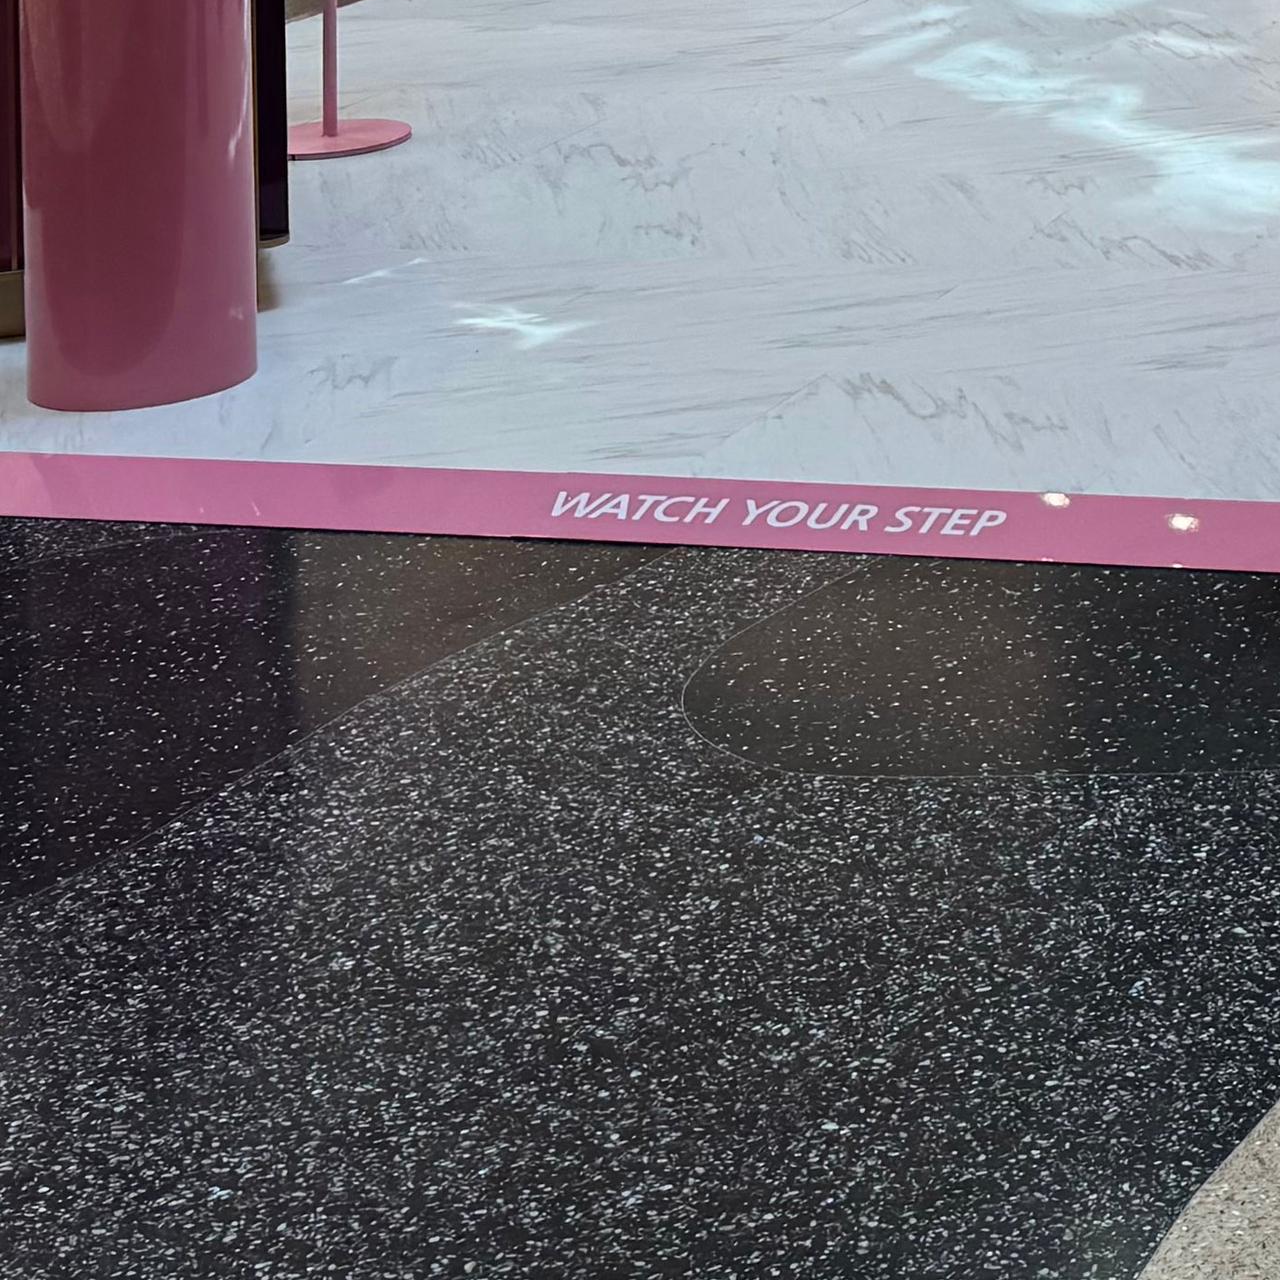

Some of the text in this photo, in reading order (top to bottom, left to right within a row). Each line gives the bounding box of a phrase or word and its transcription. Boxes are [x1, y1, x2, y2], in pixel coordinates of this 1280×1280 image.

[551, 490, 1007, 537] WATCH YOUR STEP
